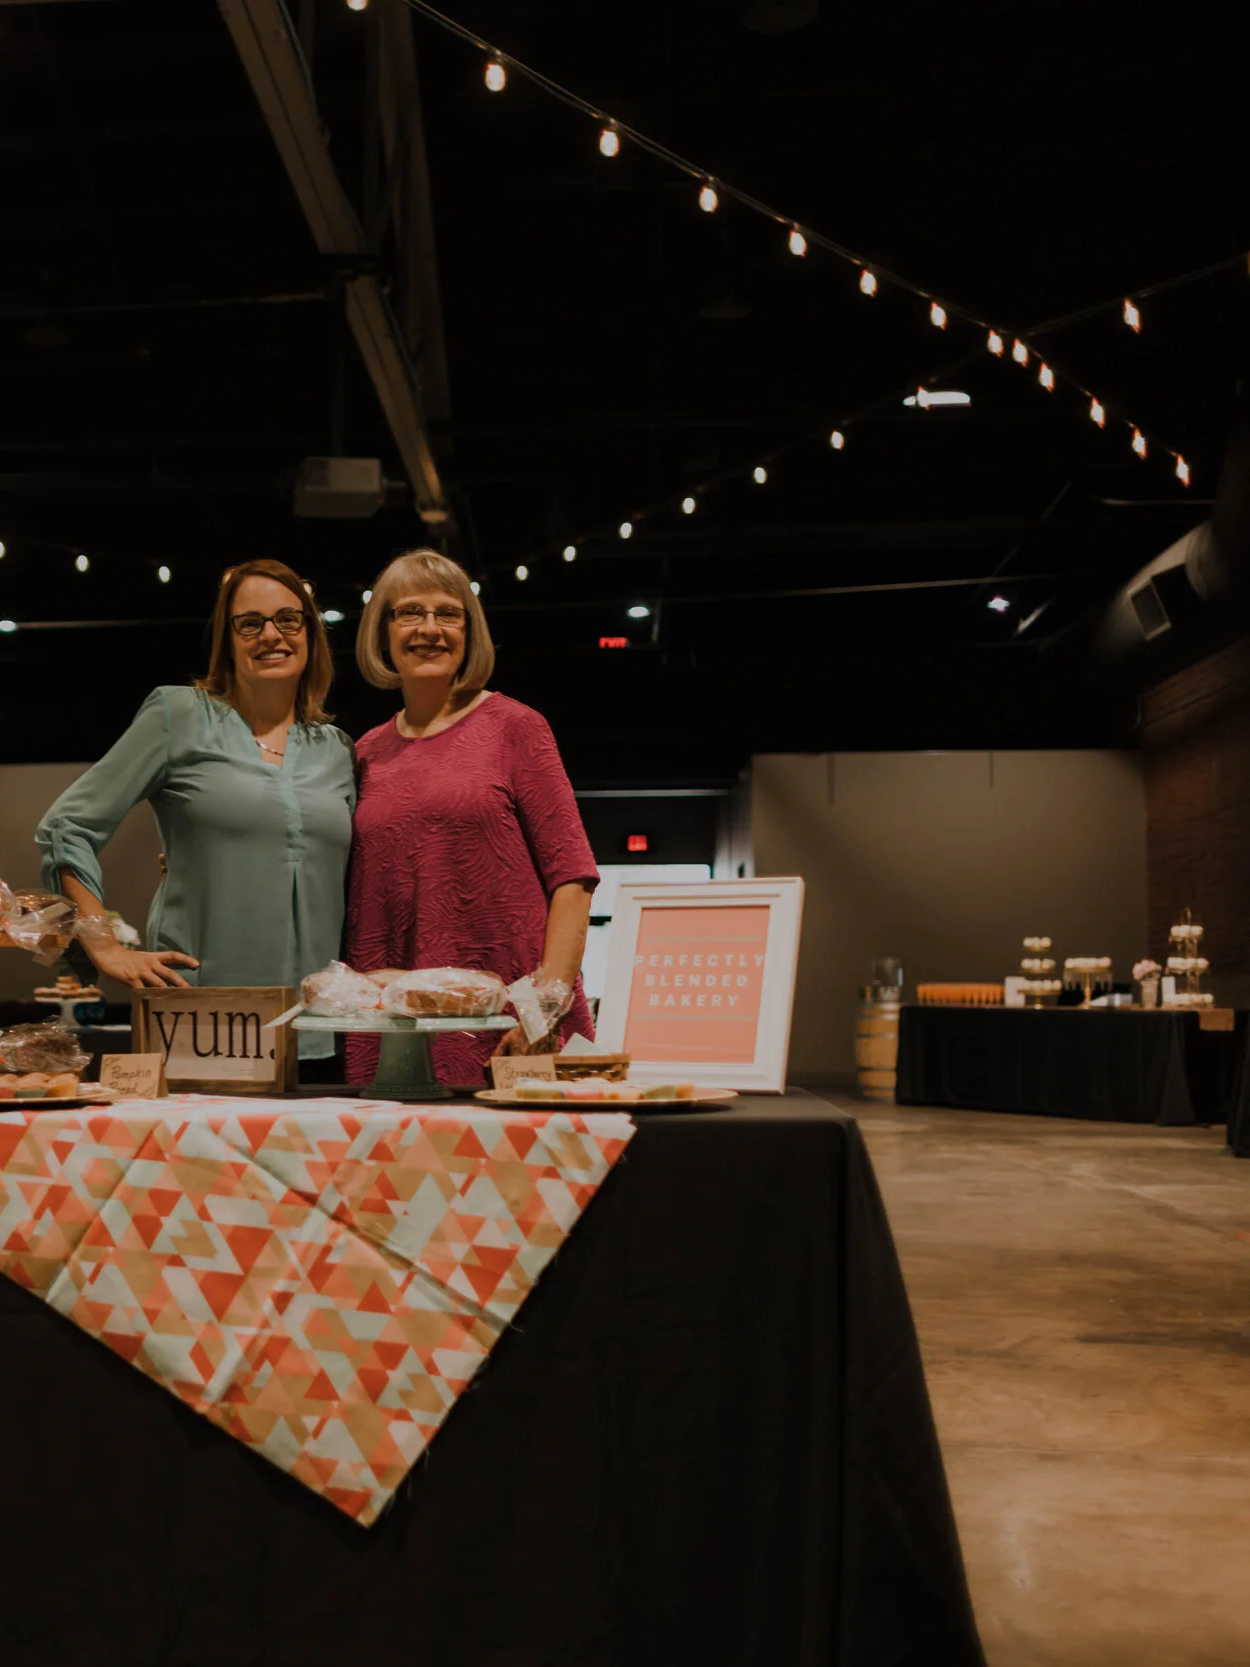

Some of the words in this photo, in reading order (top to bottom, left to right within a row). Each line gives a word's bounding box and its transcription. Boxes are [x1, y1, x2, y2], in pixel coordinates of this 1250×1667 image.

[634, 954, 764, 967] PERFECTLY
[645, 974, 748, 987] BLENDED
[648, 994, 738, 1008] BAKERY
[110, 1064, 152, 1081] Pumpkin
